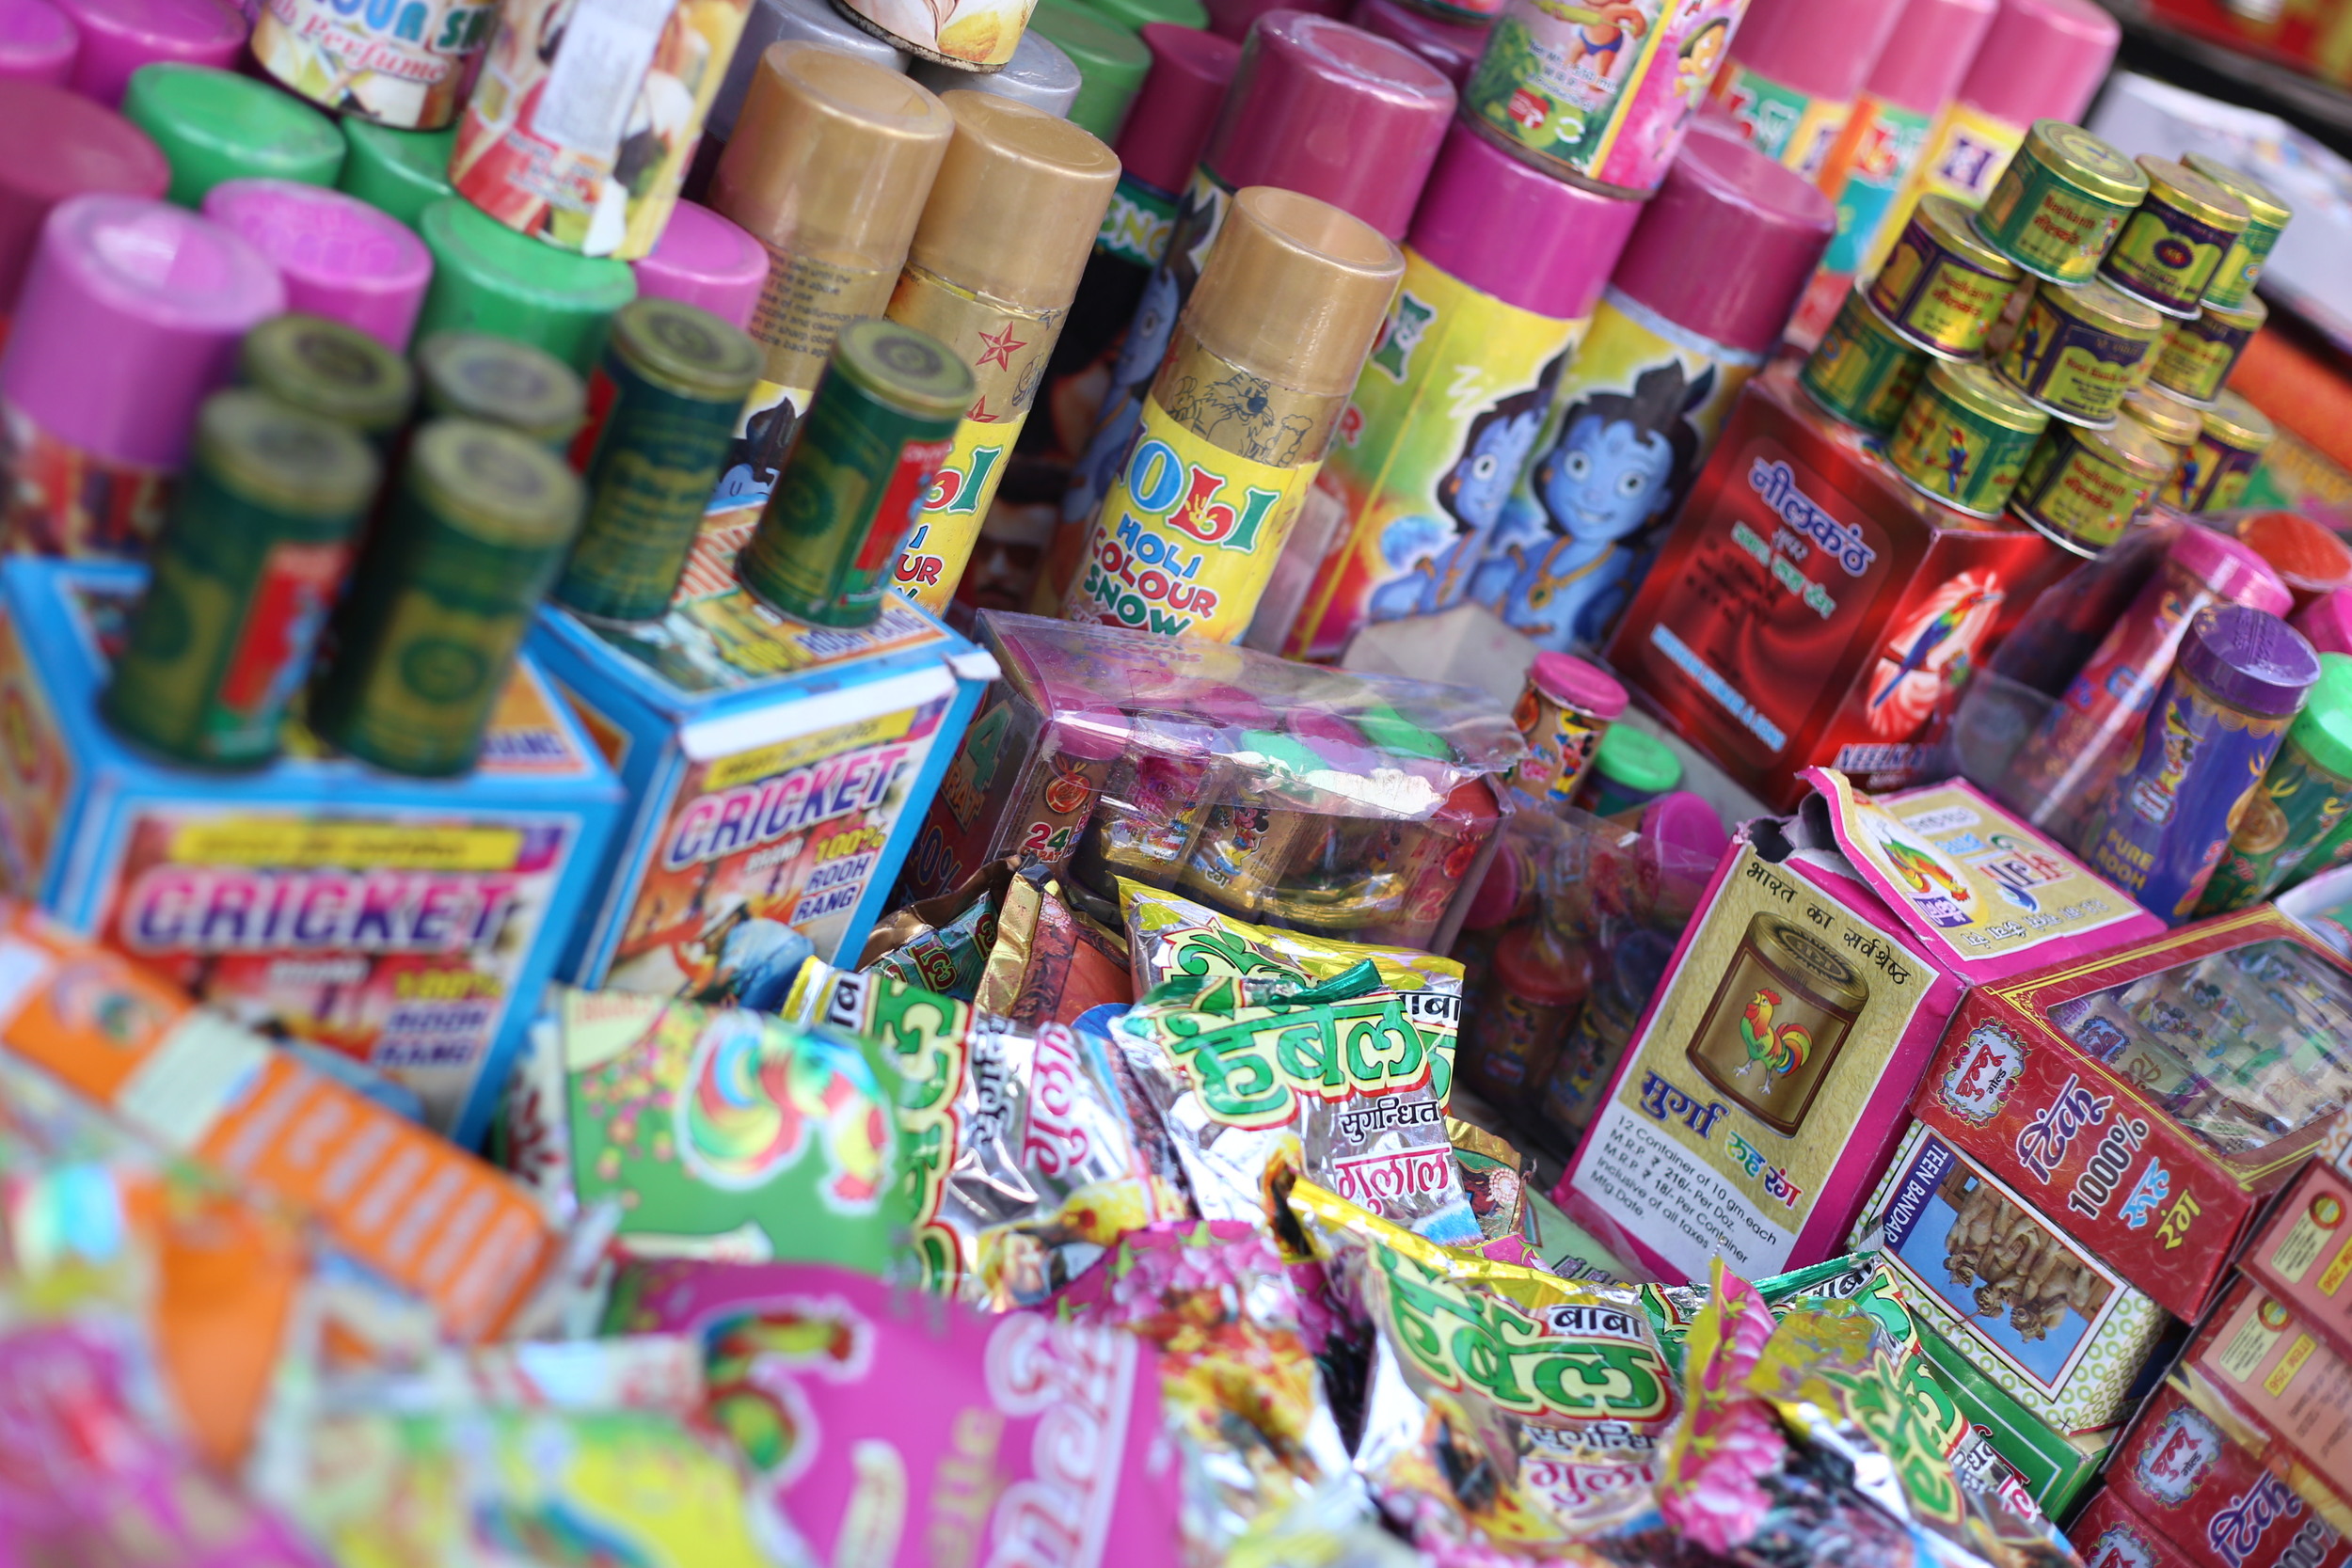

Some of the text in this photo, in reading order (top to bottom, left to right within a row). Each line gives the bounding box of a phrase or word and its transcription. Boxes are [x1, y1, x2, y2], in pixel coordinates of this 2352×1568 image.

[302, 13, 449, 83] Perfume
[1091, 526, 1218, 619] COLOUR
[1116, 514, 1202, 579] HOLI
[1083, 562, 1191, 637] SNOW
[672, 746, 910, 864] CRICKET
[1025, 823, 1071, 851] 24
[803, 854, 874, 895] ROOH
[816, 821, 888, 864] 100%
[2095, 844, 2148, 891] ROOH
[2106, 828, 2156, 873] PURE
[132, 869, 523, 946] CRICKET
[790, 884, 860, 926] RANG
[1744, 860, 1798, 904] भारत
[1805, 902, 1836, 929] का
[1842, 925, 1911, 986] सर्वश्रेष्ठ
[1641, 1068, 1731, 1142] मुर्गा
[1986, 1067, 2007, 1095] गोल्ड
[1340, 1098, 1441, 1143] सुगन्धित
[2017, 1072, 2114, 1185] टिंकू
[1334, 1146, 1451, 1216] गुलाल
[1590, 1168, 1645, 1221] Mfg.Date.
[1610, 1128, 1645, 1156] M.R.P.
[1663, 1166, 1694, 1194] 216/-
[1693, 1190, 1713, 1211] Per
[1713, 1205, 1736, 1233] Doz.
[1618, 1114, 1778, 1246] 12 Container of 10 gm.each
[1764, 1164, 1804, 1211] रंग
[1884, 1141, 1950, 1244] TEEN BANDAR
[2069, 1112, 2150, 1221] 1000%
[1597, 1156, 1710, 1250] Inclusive of all taxes
[1602, 1142, 1640, 1171] M.R.P.
[1654, 1178, 1675, 1200] 18/-
[1675, 1195, 1695, 1215] Per
[1696, 1212, 1750, 1264] Container
[2153, 1189, 2203, 1252] रंग
[1530, 1460, 1656, 1506] गुला
